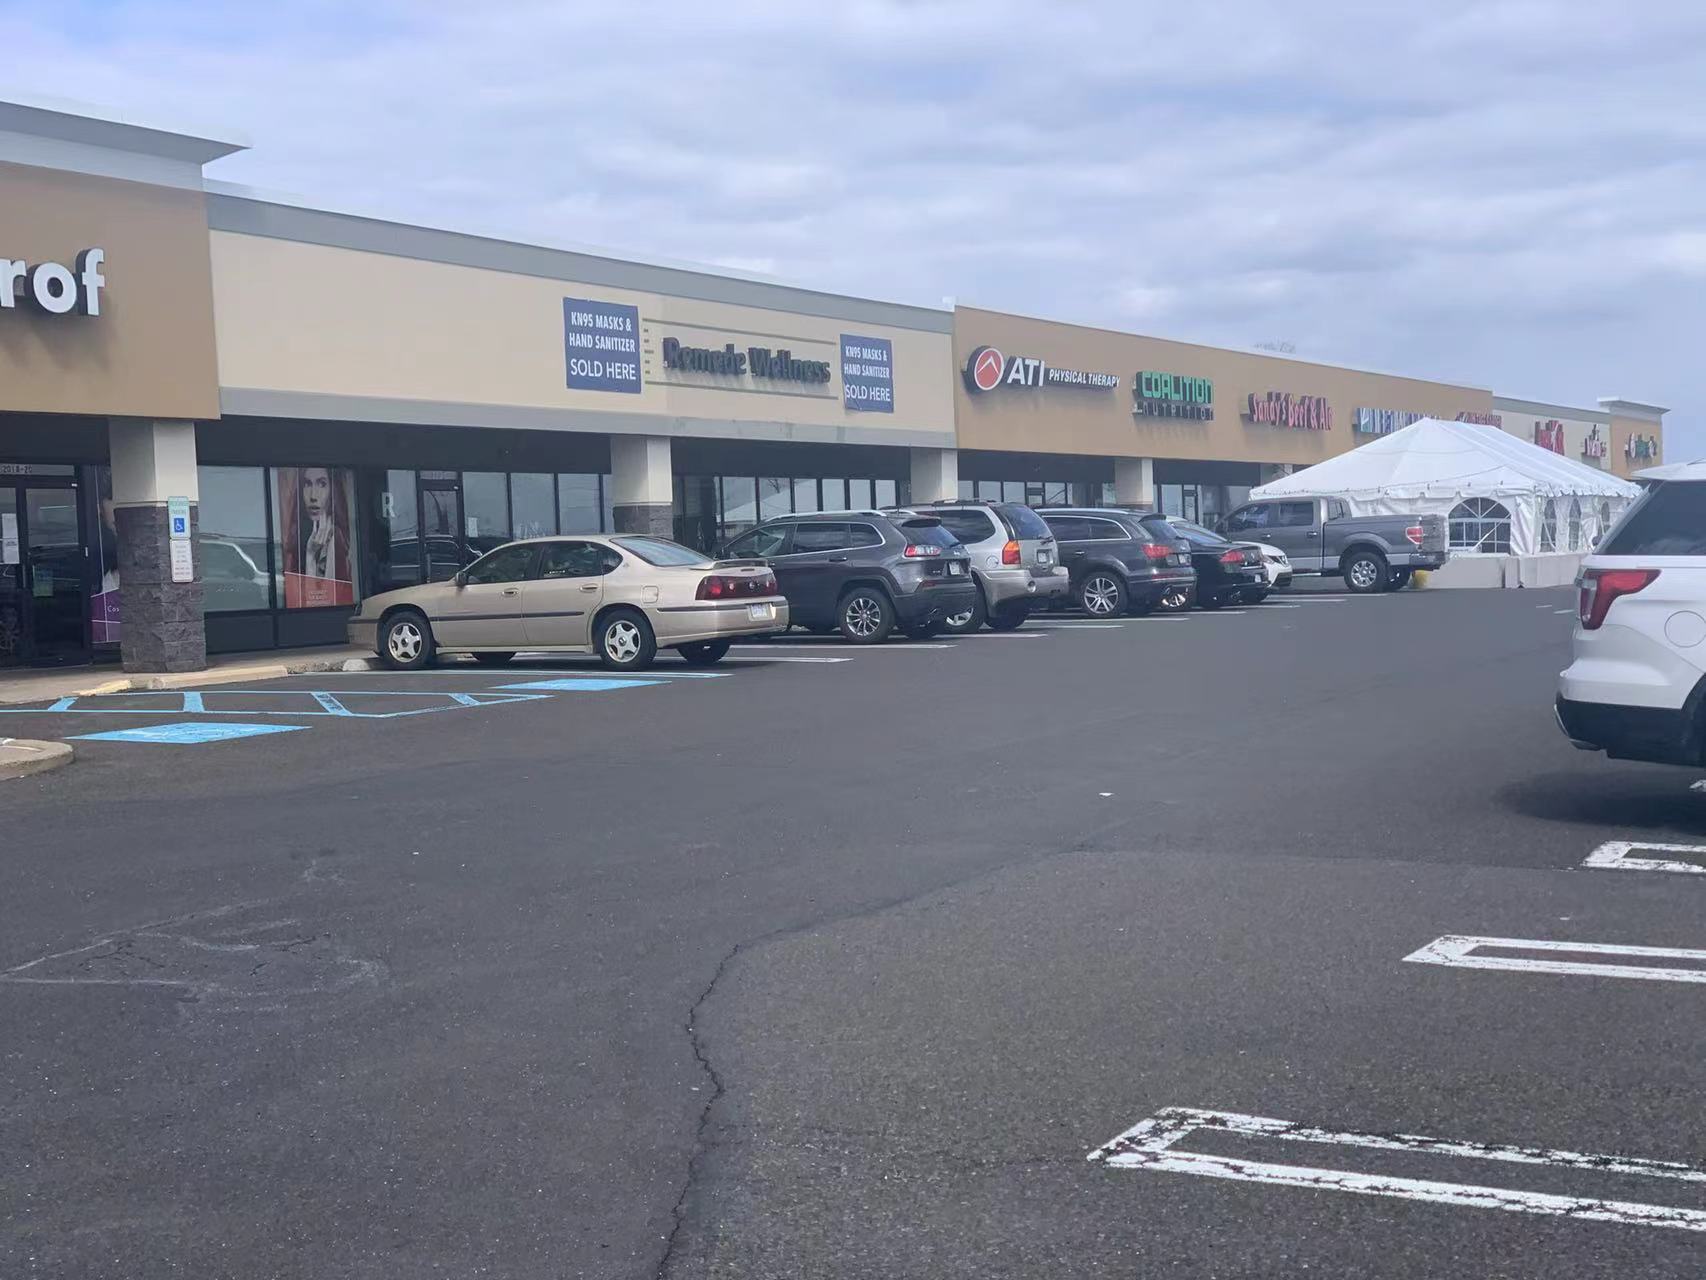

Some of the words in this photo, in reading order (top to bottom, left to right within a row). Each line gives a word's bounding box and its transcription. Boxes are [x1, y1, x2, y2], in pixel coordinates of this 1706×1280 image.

[571, 311, 594, 328] KN95
[595, 313, 623, 331] MASKS
[625, 317, 632, 332] &
[569, 333, 593, 349] HAND
[595, 335, 636, 353] SANITIZER
[845, 345, 861, 359] KN95
[862, 347, 882, 361] MASKS
[882, 350, 888, 362] &
[570, 359, 603, 378] SOLD
[606, 360, 637, 380] HERE
[748, 347, 831, 384] Wellness
[844, 363, 860, 377] HAND
[861, 365, 890, 379] SANITIZER
[1007, 358, 1045, 387] ATI
[1049, 368, 1087, 384] PHYSICAL
[1088, 372, 1121, 388] THERAPY
[845, 384, 868, 400] SOLD
[869, 386, 891, 402] HERE
